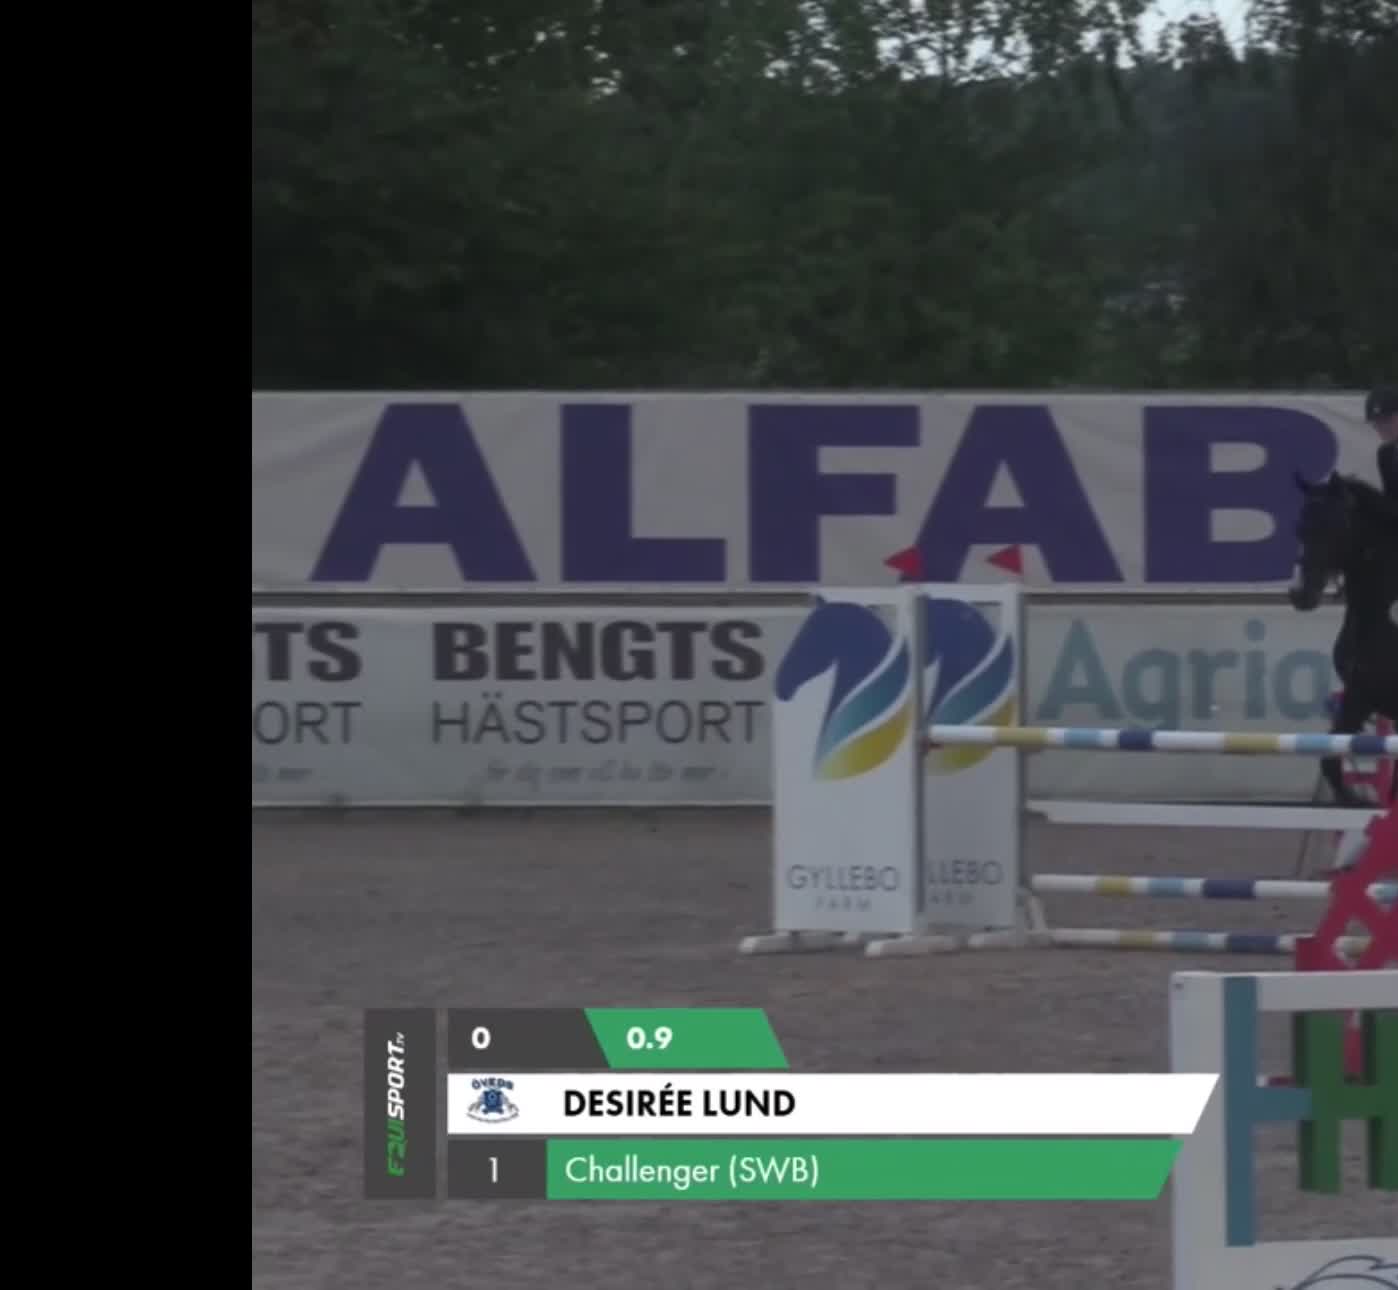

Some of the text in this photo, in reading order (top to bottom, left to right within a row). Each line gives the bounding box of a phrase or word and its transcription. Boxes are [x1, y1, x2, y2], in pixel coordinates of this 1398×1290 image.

[308, 403, 1339, 583] ALFAB
[433, 621, 765, 682] BENGTS
[1037, 620, 1332, 728] Agria
[433, 692, 765, 745] HÄSTSPORT
[787, 864, 899, 891] GYLLEBO
[816, 896, 872, 912] FARM
